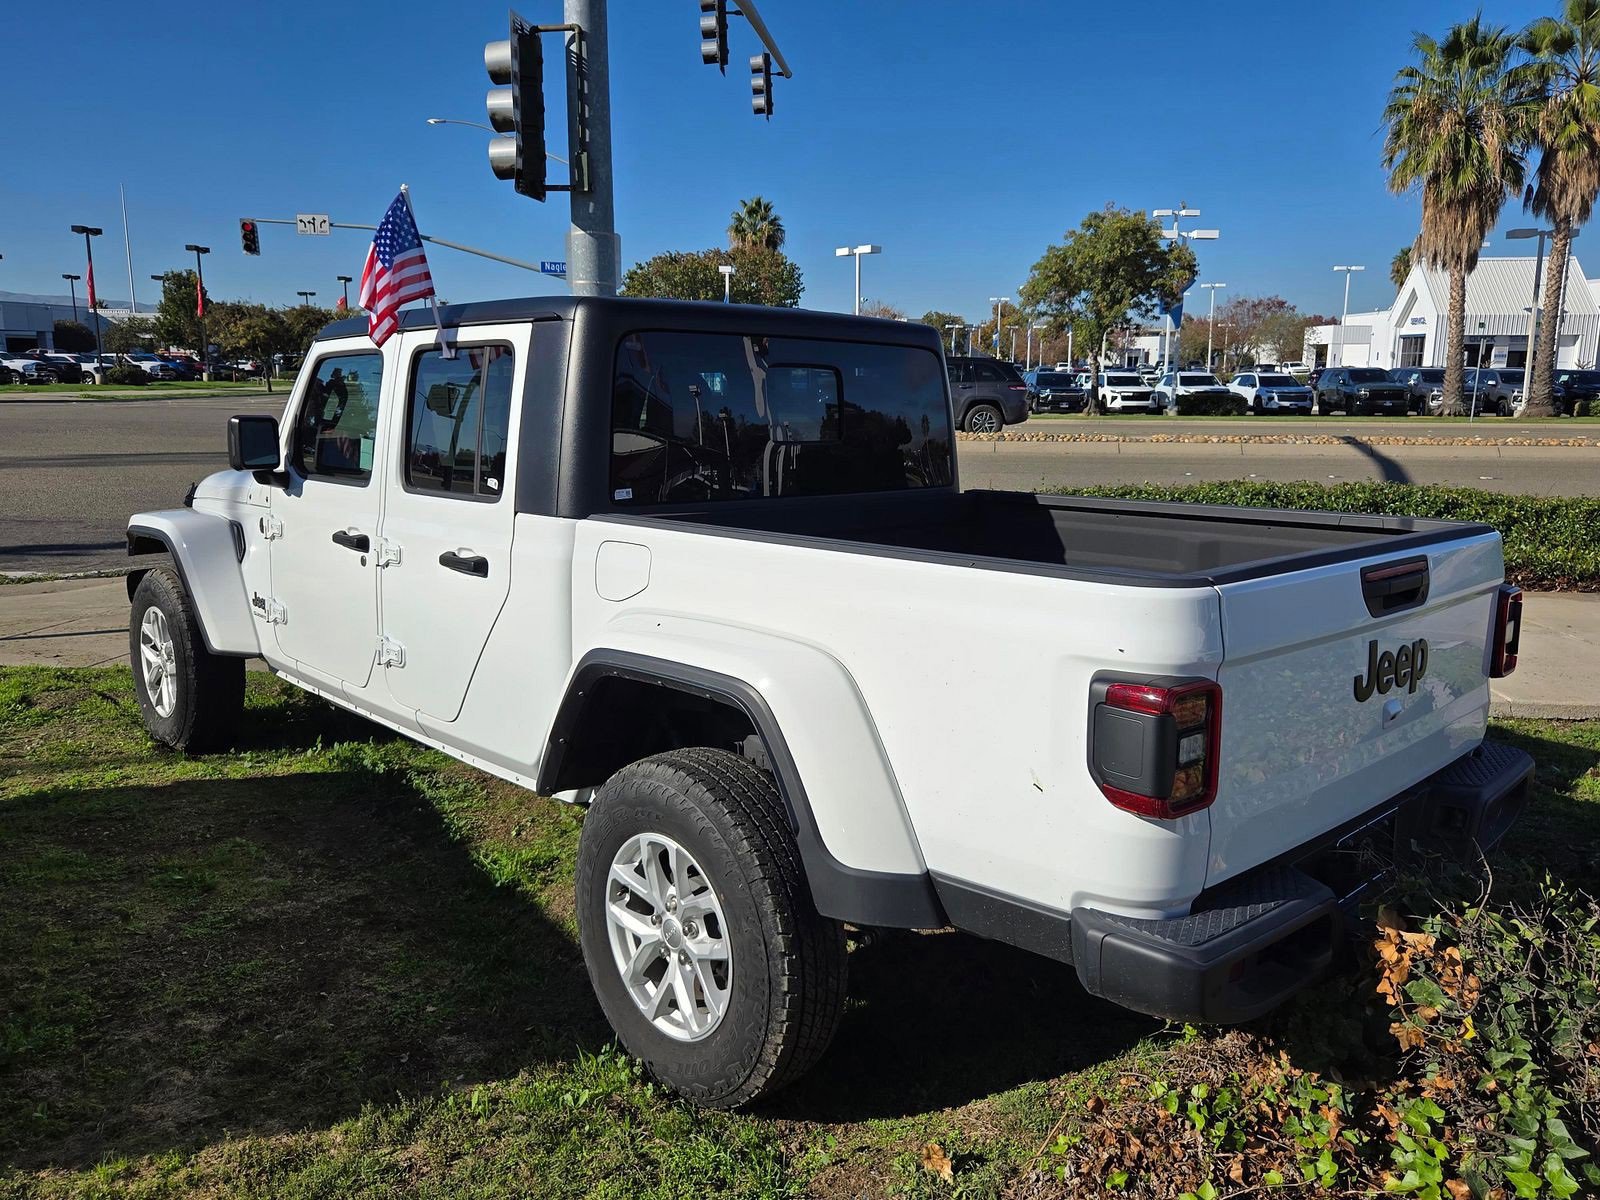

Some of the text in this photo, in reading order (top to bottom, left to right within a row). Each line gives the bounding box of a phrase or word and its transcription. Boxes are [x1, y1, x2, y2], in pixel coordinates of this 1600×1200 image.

[544, 262, 566, 272] Nagle
[252, 591, 266, 614] Jeep
[1353, 638, 1429, 703] Jeep
